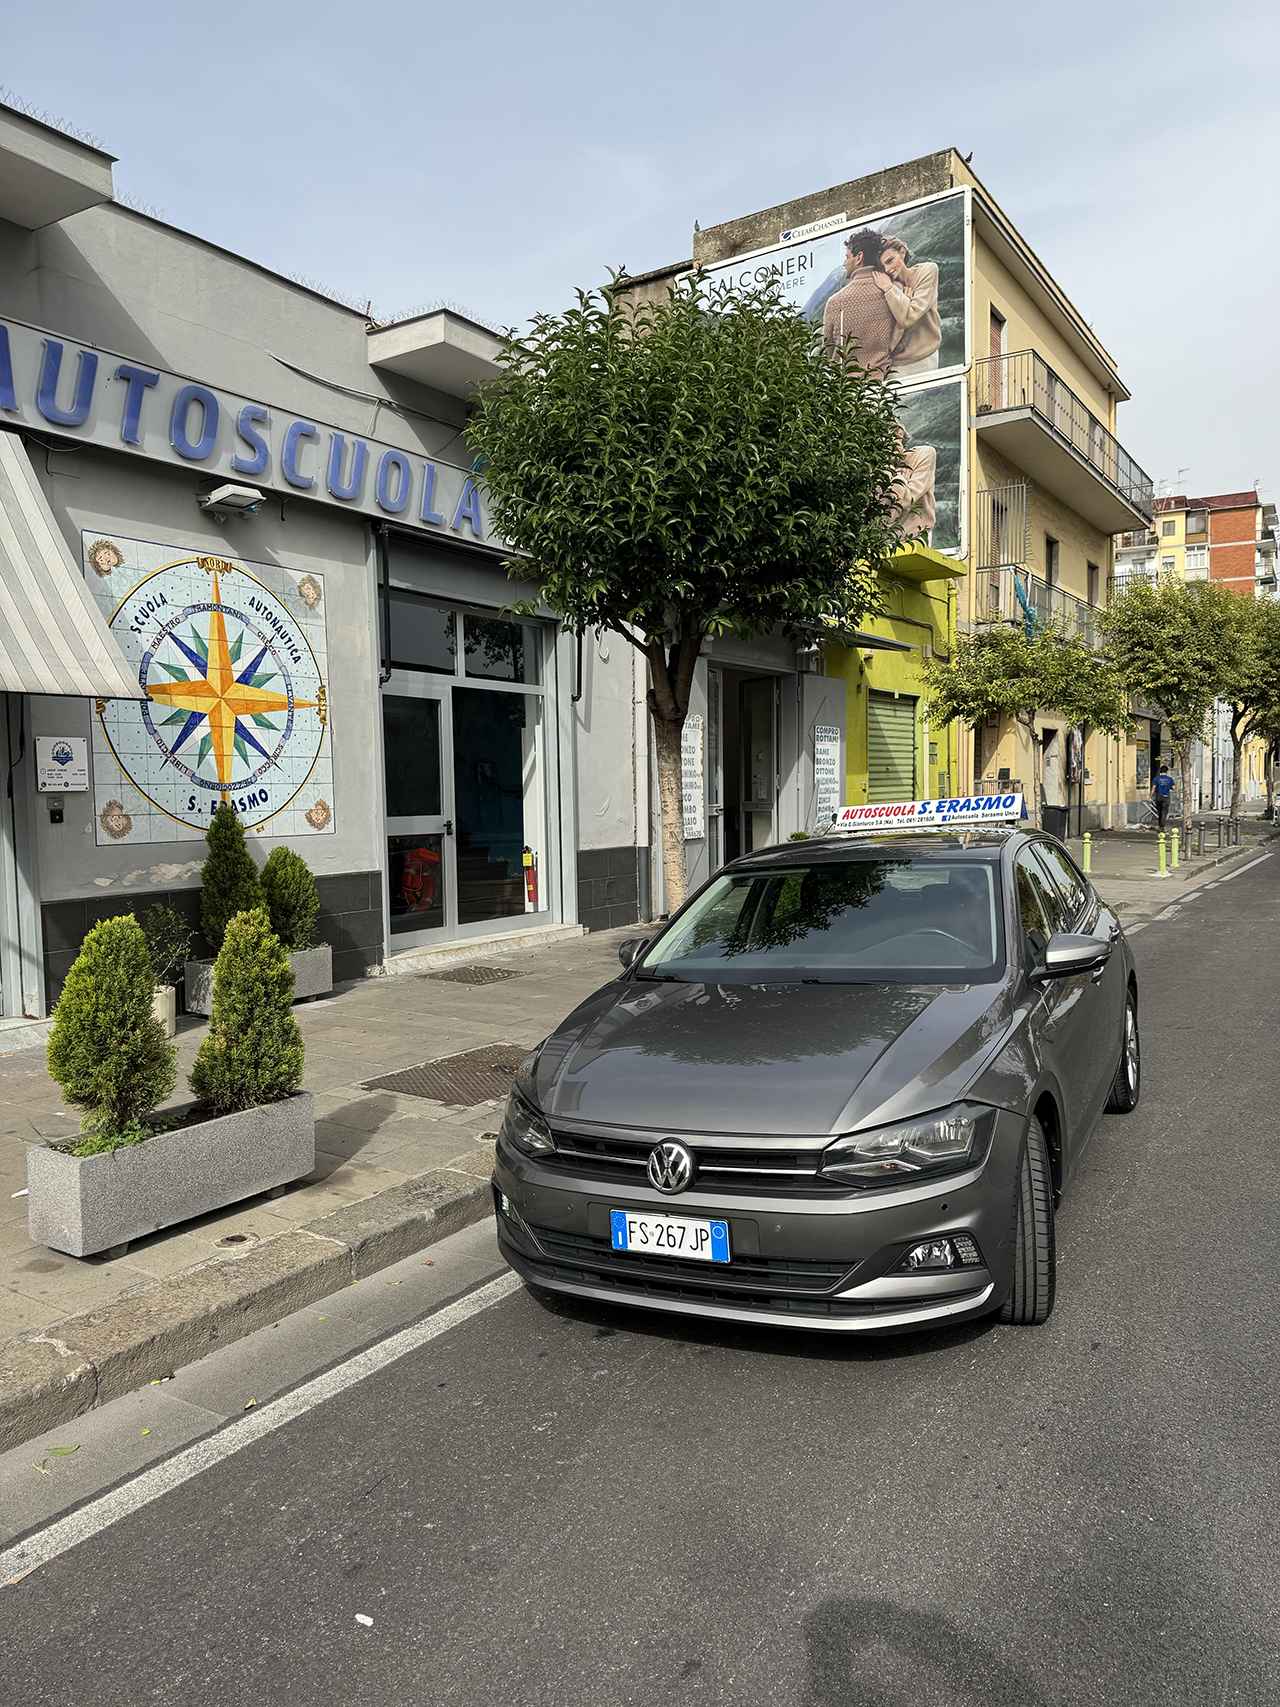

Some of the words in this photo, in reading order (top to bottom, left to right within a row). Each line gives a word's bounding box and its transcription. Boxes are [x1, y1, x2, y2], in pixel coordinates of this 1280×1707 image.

[709, 252, 814, 297] FALCONERI
[130, 592, 168, 634] SCUOLA
[151, 617, 181, 650] MAESTRO
[248, 596, 302, 664] AUTONAUTICA
[816, 727, 838, 736] COMPRO
[187, 795, 202, 813] S.
[842, 805, 915, 820] AUTOSCUOLA
[628, 1221, 649, 1244] FS
[655, 1223, 686, 1249] 267
[689, 1228, 710, 1251] JP
